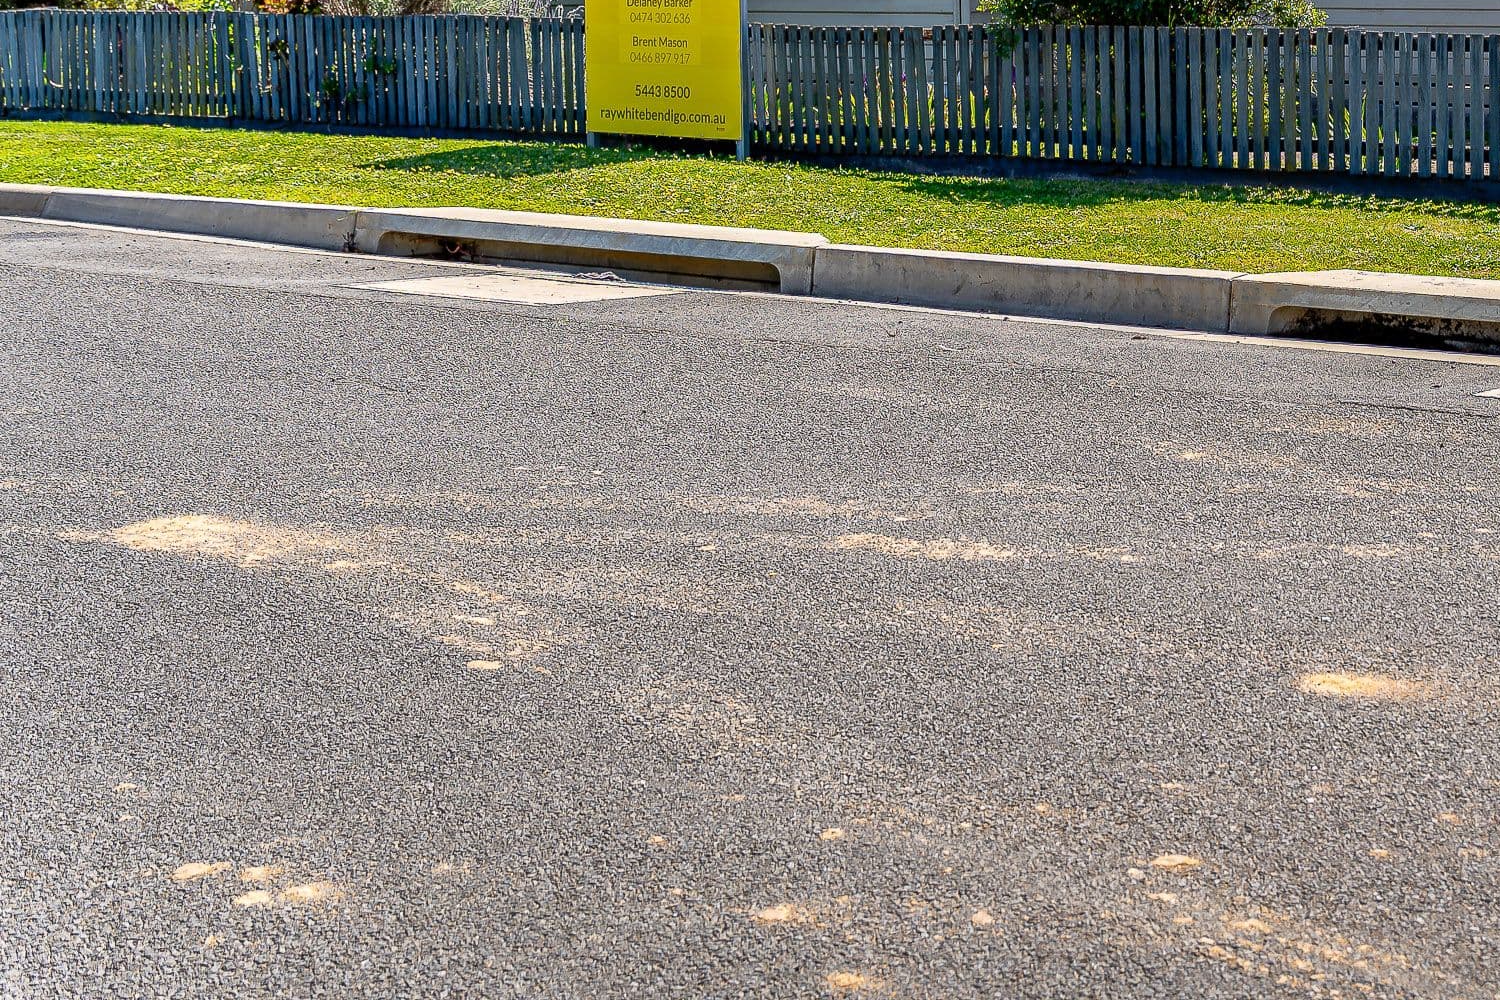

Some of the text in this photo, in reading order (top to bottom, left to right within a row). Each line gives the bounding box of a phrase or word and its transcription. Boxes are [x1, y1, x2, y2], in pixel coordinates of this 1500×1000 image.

[630, 12, 690, 24] 0474 302 636
[633, 36, 688, 48] Brent Mason
[630, 51, 690, 65] 0466 897 917
[635, 84, 691, 99] 5443 8500
[600, 106, 726, 125] raywhitebendigo.com.au
